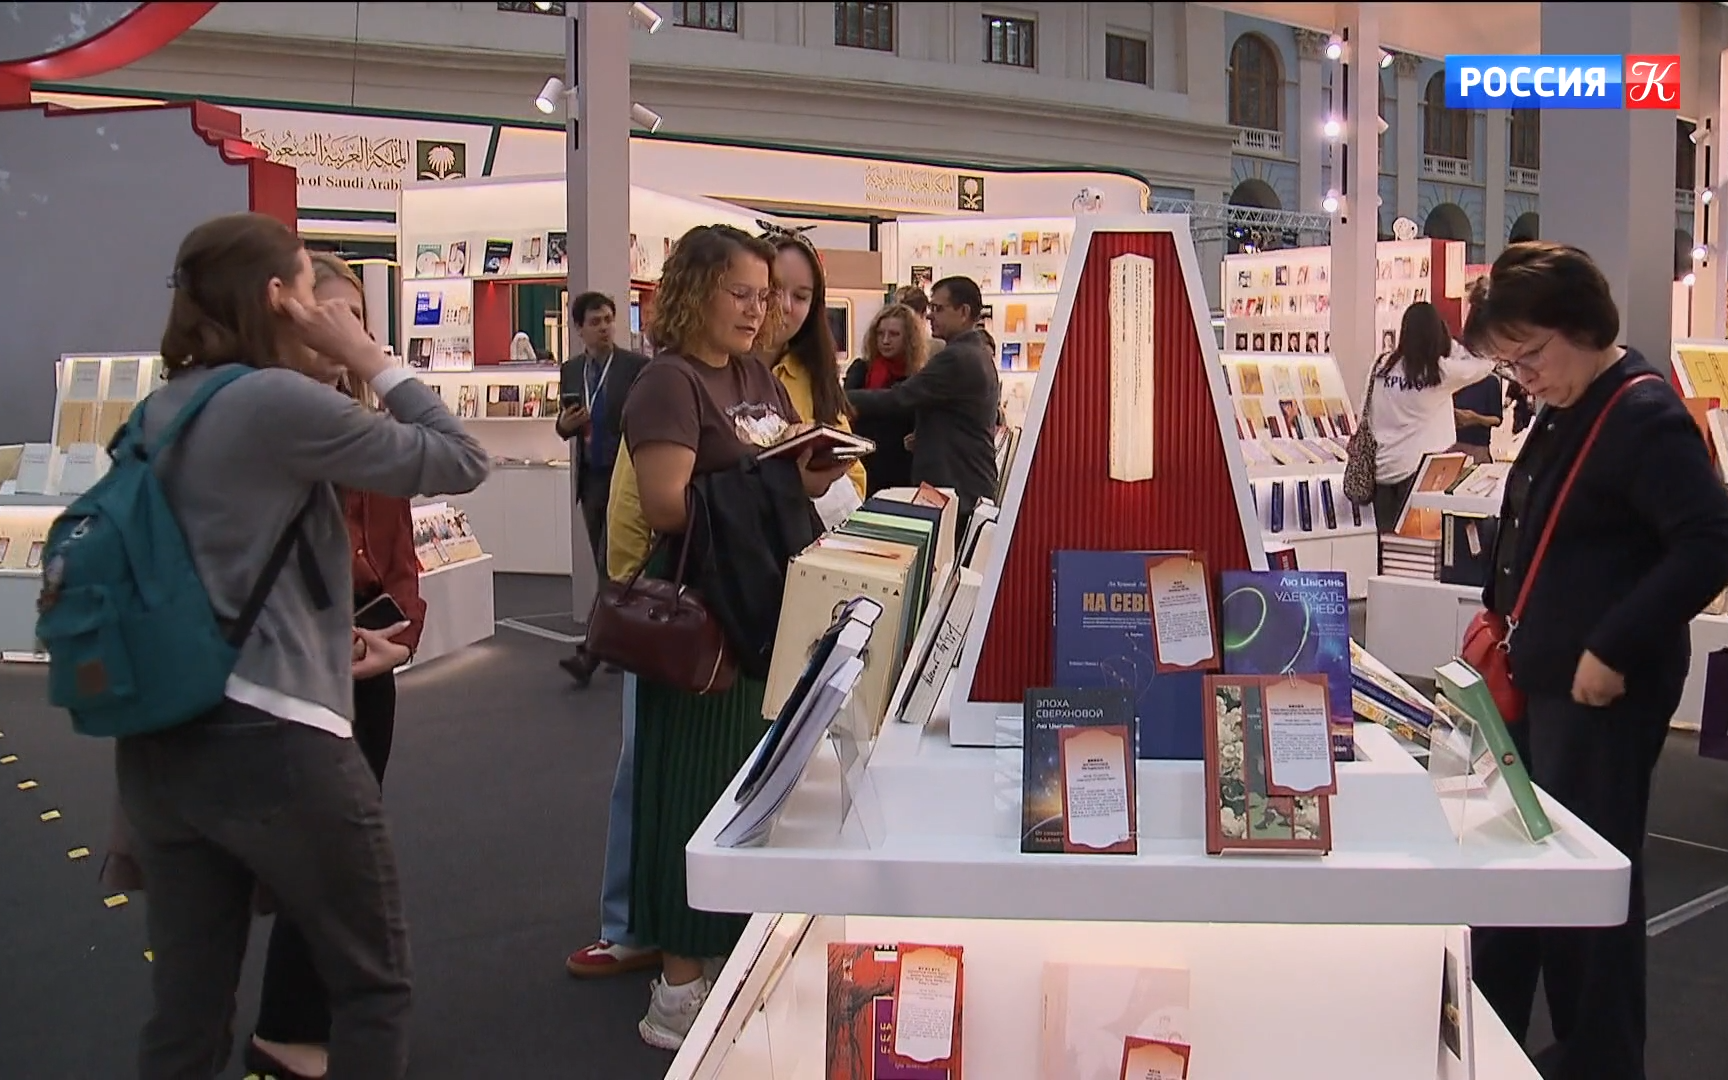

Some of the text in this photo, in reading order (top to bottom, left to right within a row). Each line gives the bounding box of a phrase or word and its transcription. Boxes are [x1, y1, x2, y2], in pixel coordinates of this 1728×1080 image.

[308, 175, 322, 187] of
[326, 177, 364, 189] Saudi
[367, 177, 402, 191] Arabi
[1280, 577, 1345, 588] Лю Цысинь
[1274, 591, 1345, 602] УДЕРЖАТЬ
[1082, 592, 1107, 613] НА
[1309, 603, 1346, 615] НЕБО
[1036, 699, 1070, 708] ЭПОХА
[1035, 708, 1104, 718] СВЕРХНОВОЙ
